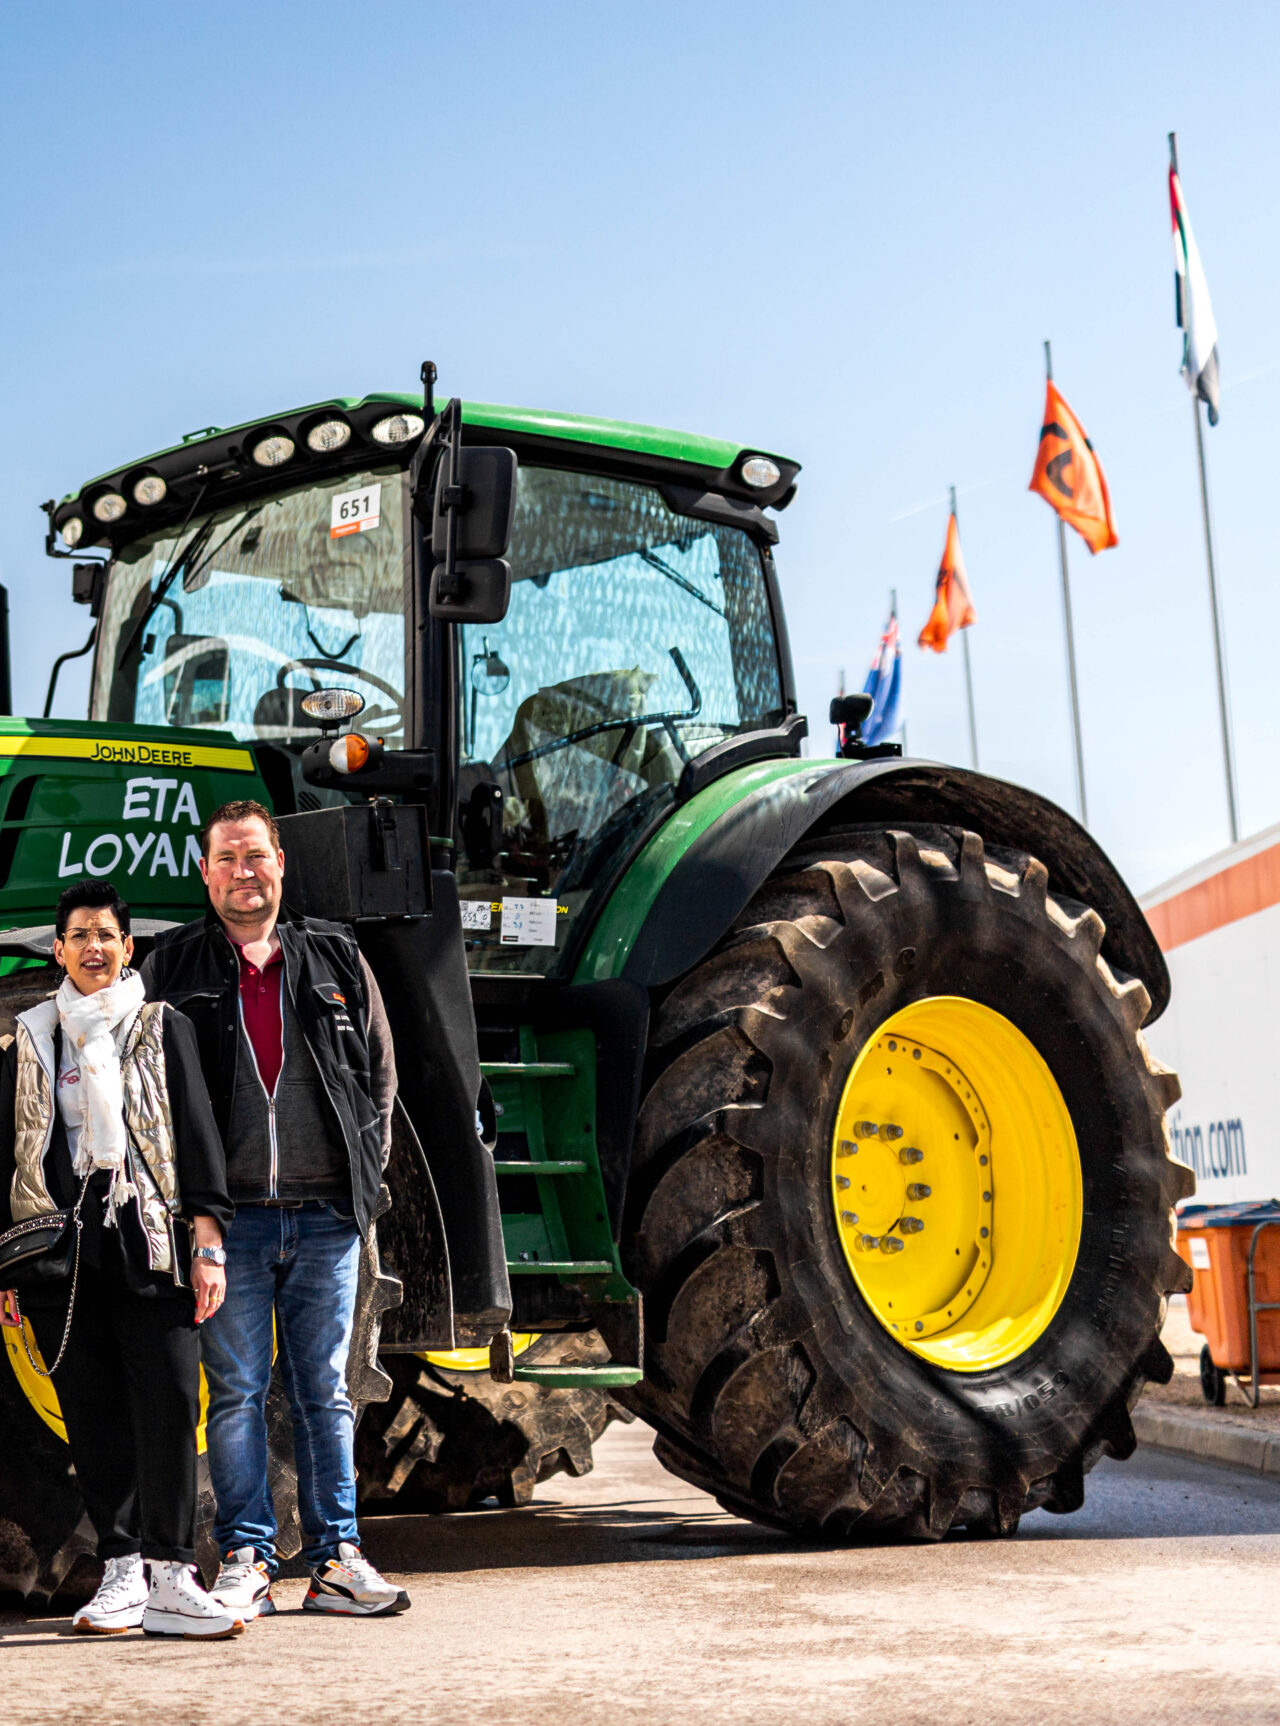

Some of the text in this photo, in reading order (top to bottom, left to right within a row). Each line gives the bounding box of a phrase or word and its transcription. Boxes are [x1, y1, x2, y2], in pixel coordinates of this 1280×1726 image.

[340, 494, 370, 519] 651
[91, 742, 193, 765] JOHN DEERE
[122, 776, 201, 826] ETA
